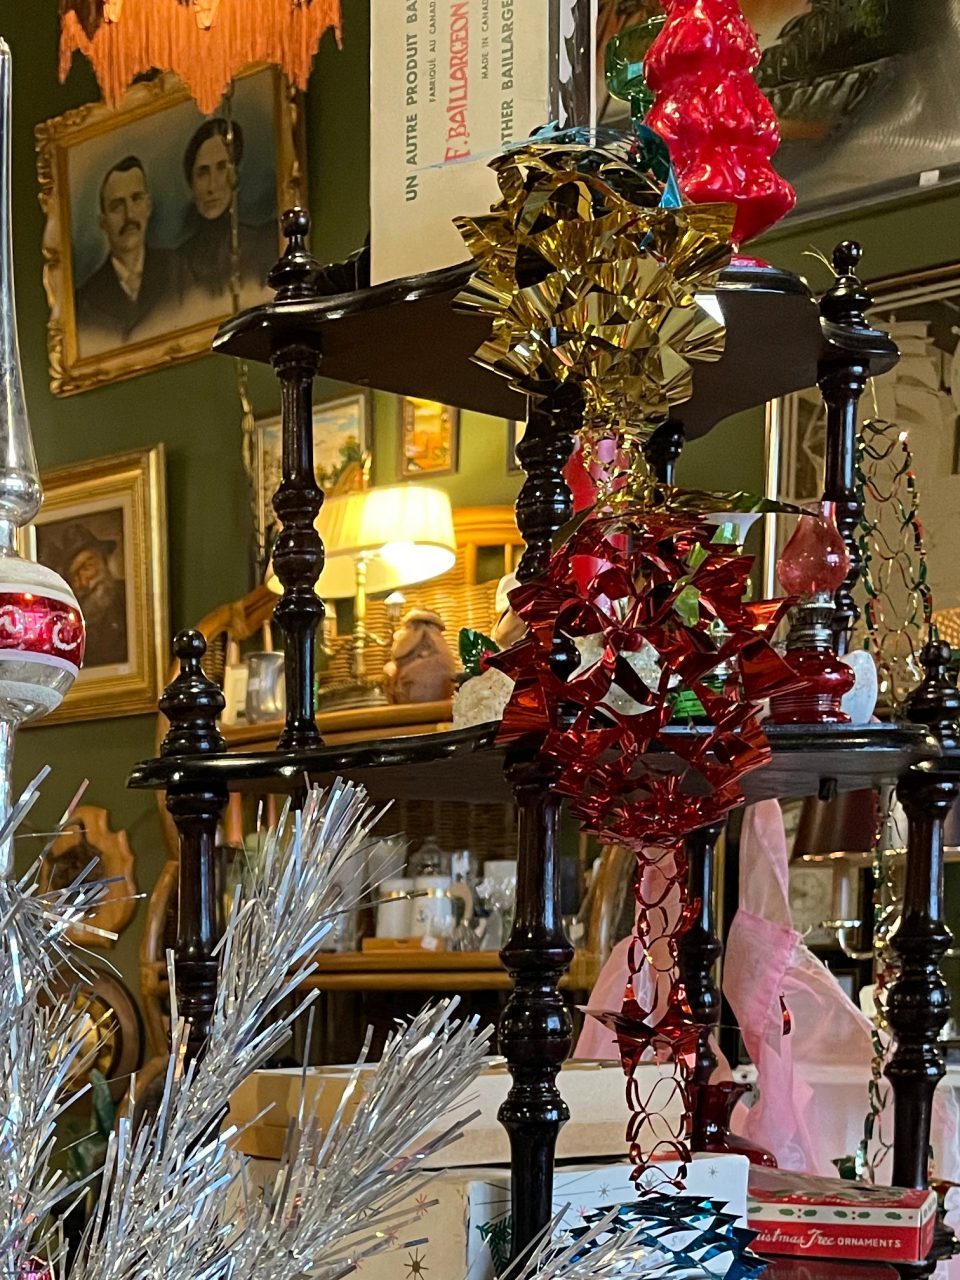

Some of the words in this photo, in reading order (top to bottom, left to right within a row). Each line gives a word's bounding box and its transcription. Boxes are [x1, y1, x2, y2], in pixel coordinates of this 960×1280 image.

[406, 0, 418, 24] BA
[428, 1, 437, 35] CANAD
[481, 0, 489, 32] CANAD
[428, 39, 437, 53] AU
[481, 36, 489, 48] IN
[500, 0, 514, 90] BAILLARGE
[406, 33, 418, 106] PRODUIT
[447, 1, 470, 138] BAILLARGEON
[481, 52, 489, 79] MADE
[406, 113, 418, 165] AUTRE
[406, 175, 419, 201] UN
[800, 1228, 836, 1249] Tree
[837, 1237, 901, 1248] ORNAMENTS
